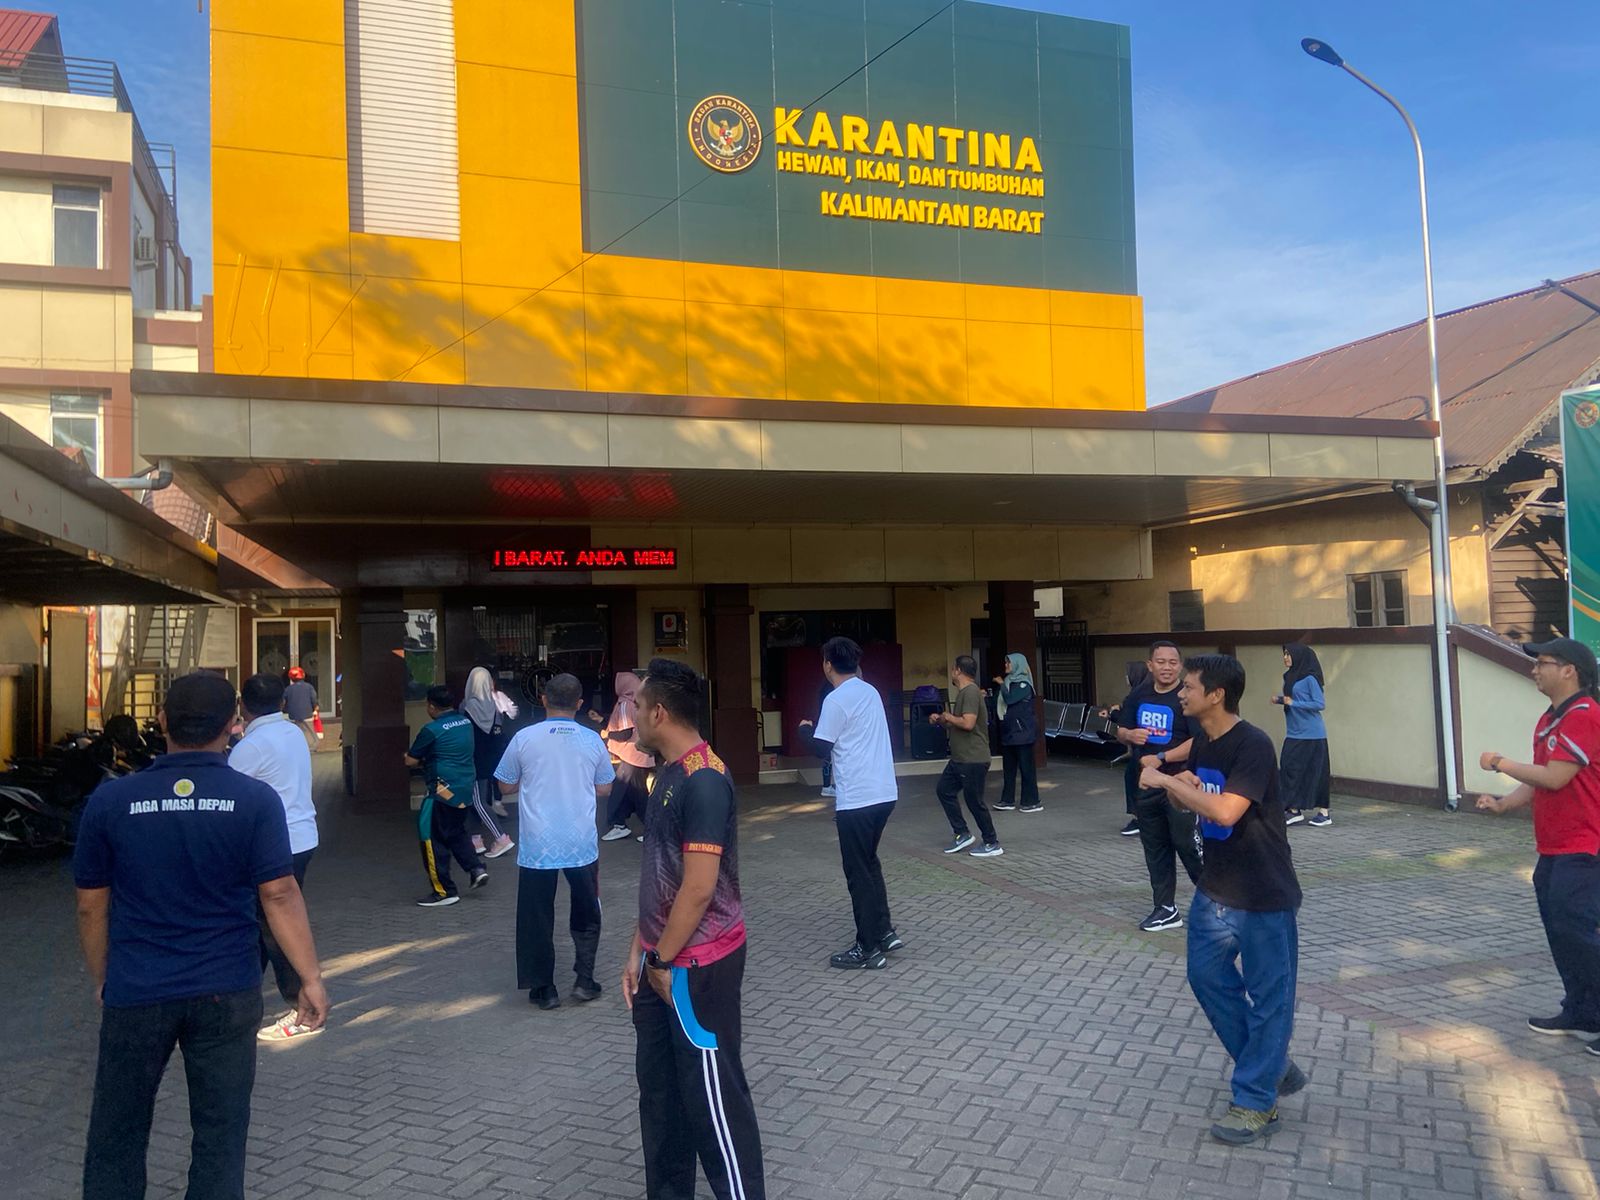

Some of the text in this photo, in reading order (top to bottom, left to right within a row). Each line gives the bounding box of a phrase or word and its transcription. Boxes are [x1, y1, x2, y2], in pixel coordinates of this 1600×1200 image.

[694, 98, 756, 129] BADAN KARANTINA
[695, 137, 757, 168] INDONESIA
[775, 107, 1043, 174] KARANTINA
[777, 150, 1045, 198] HEWAN, IKAN, DAN TUMBUHAN
[820, 190, 1045, 234] KALIMANTAN BARAT
[504, 551, 568, 566] BARAT.
[576, 551, 628, 566] ANDA
[1141, 710, 1168, 729] BRI
[129, 798, 235, 815] JAGA MASA DEPAN
